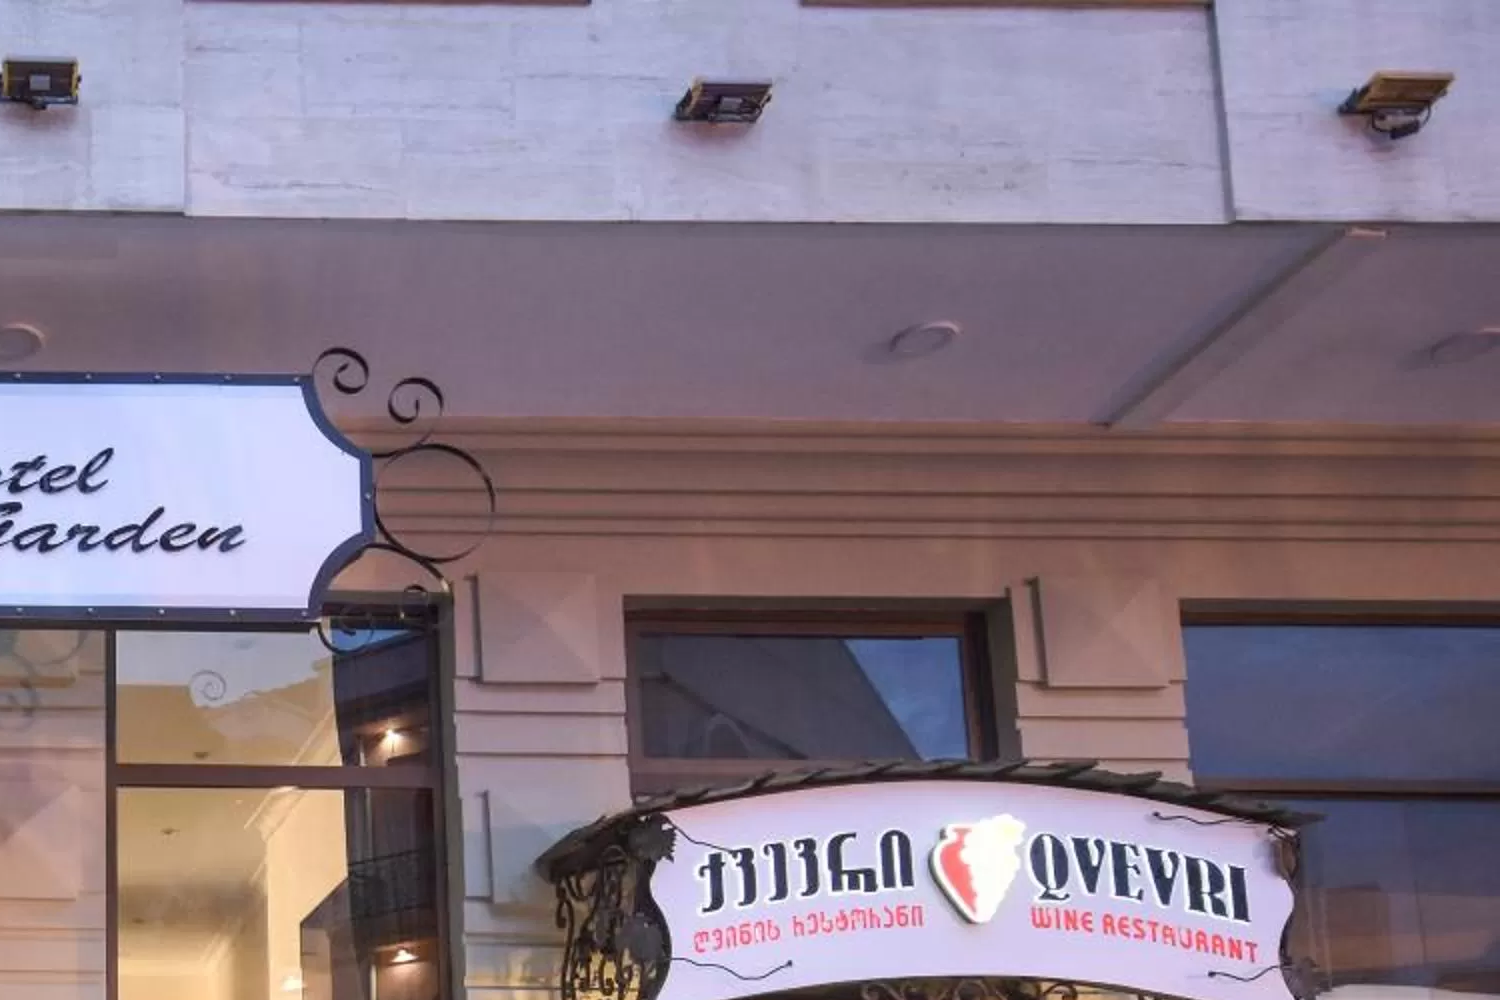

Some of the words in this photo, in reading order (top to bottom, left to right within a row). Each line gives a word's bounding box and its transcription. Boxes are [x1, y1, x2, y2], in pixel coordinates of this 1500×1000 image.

[698, 828, 915, 914] ქვევრი
[1029, 832, 1252, 924] QVEVRI
[693, 918, 781, 954] ღვინის
[792, 904, 925, 938] რესტორანი
[1031, 905, 1094, 933] WINE
[1102, 913, 1258, 963] RESTAURANT
